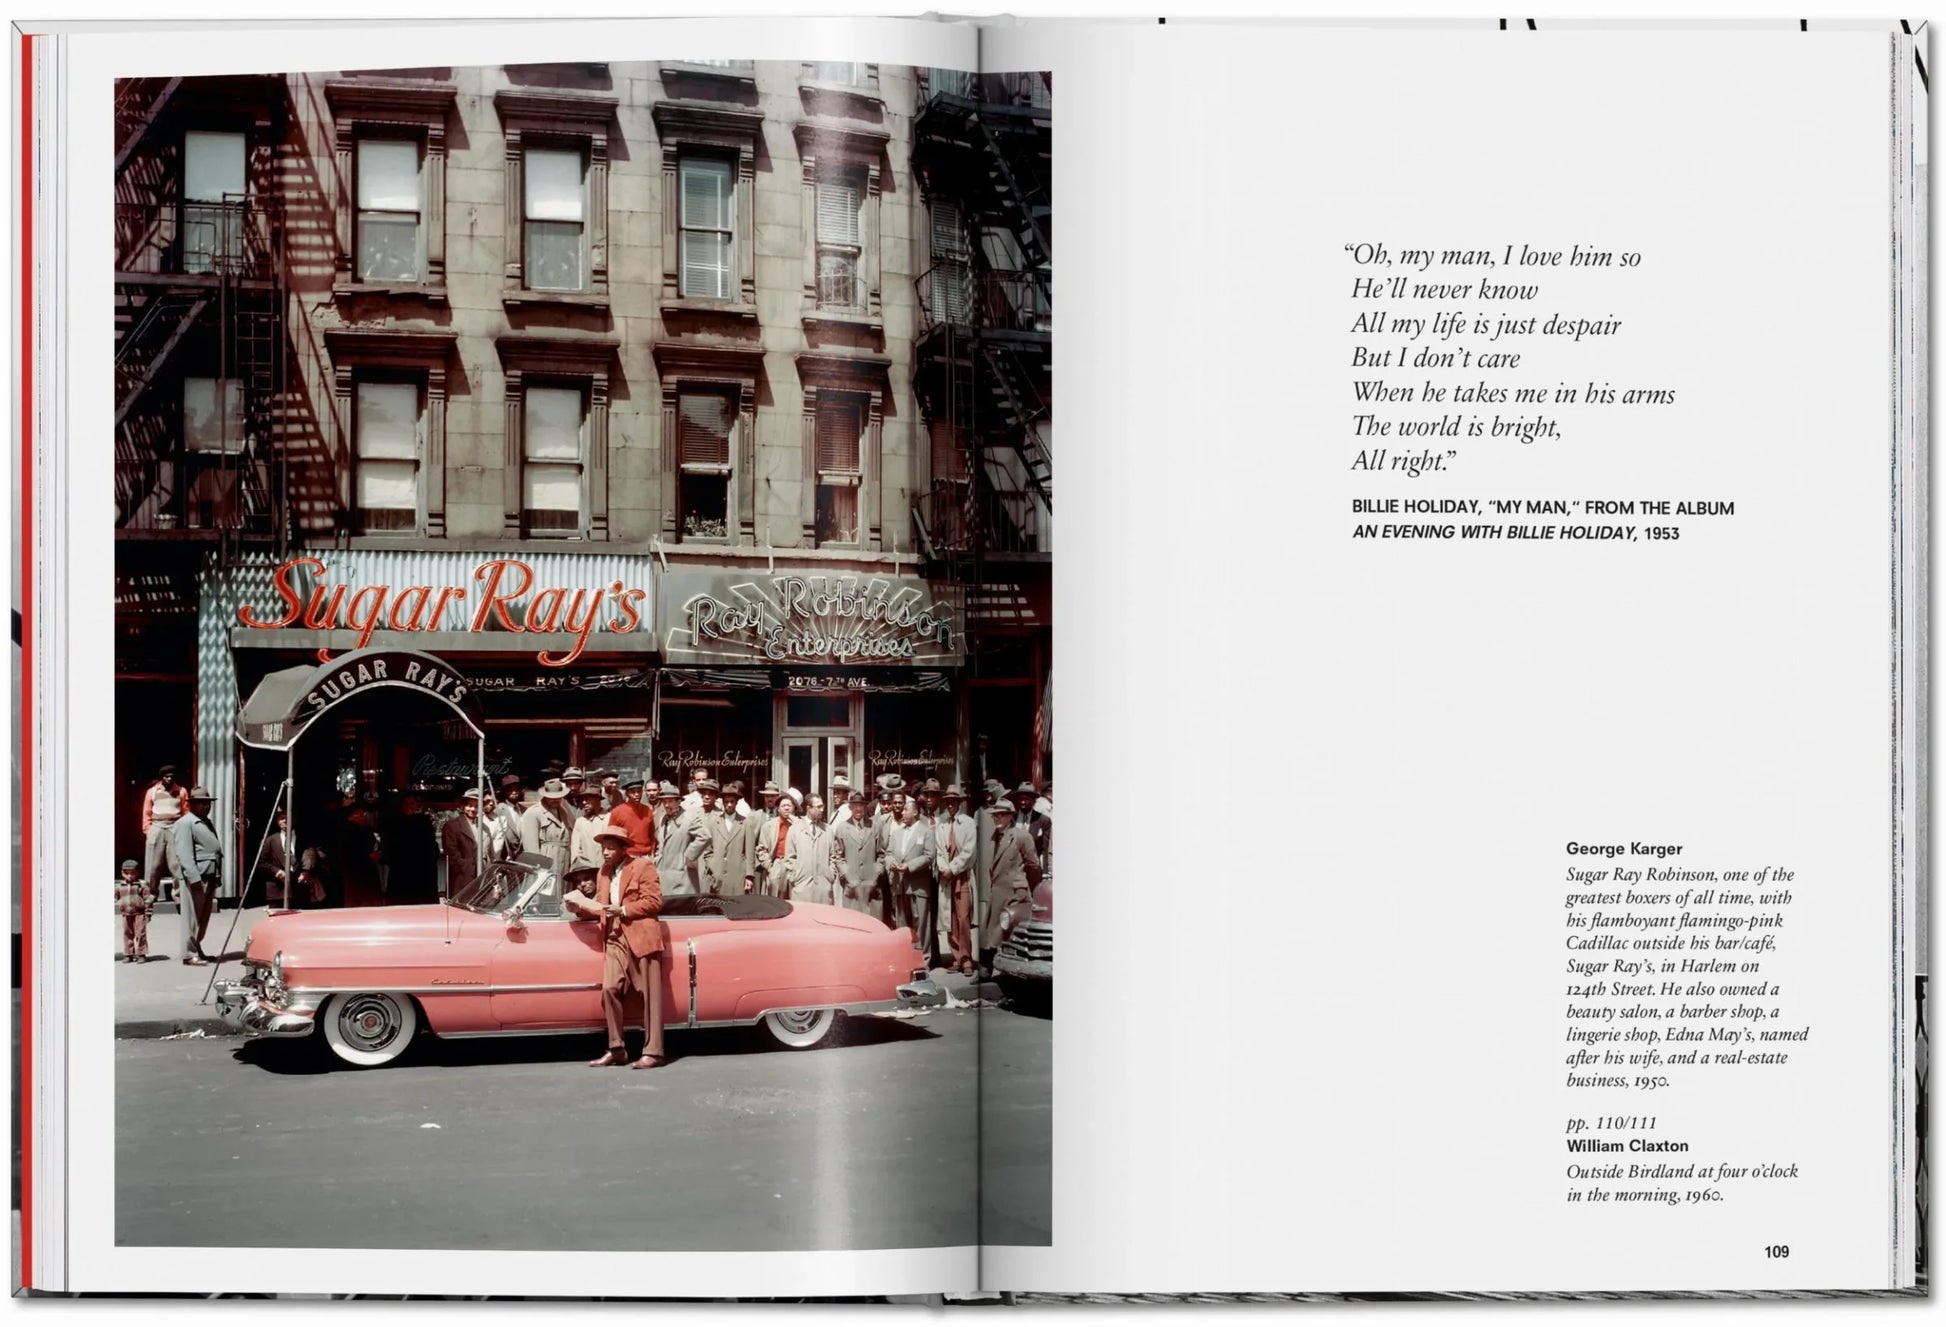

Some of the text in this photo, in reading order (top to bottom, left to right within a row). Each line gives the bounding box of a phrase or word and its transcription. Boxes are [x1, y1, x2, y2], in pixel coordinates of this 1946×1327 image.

[1344, 242, 1641, 272] “Oh, my man, I love him so
[1351, 277, 1538, 300] He’ll never know
[1350, 311, 1622, 341] All my life is just despair
[1351, 346, 1520, 368] But I don’t care
[1353, 380, 1675, 404] When he takes me in his arms
[1353, 414, 1560, 444] The world is bright,
[1351, 448, 1456, 478] All right.”
[1352, 499, 1734, 516] BILLIE HOLIDAY, “MY MAN,“ FROM THE ALBUM
[1352, 524, 1680, 542] AN EVENING WITH BILLIE HOLIDAY, 1953
[239, 557, 647, 667] Sugar Ray’s
[692, 577, 955, 650] Ray Robinson
[766, 624, 916, 663] Enterprises
[307, 659, 467, 710] SUGAR RAY’S
[466, 676, 515, 687] SUGAR
[658, 750, 681, 773] Ray
[1566, 841, 1683, 859] George Karger
[1566, 866, 1794, 886] Sugar Ray Robinson, one of the
[1565, 889, 1792, 908] greatest boxers of all time, with
[1566, 912, 1783, 931] his flamboyant flamingo-pink
[1566, 934, 1775, 954] Cadillac outside his bar/café,
[1566, 958, 1759, 977] Sugar Ray’s, in Harlem on
[1566, 981, 1779, 998] 124th Street. He also owned a
[1566, 1003, 1779, 1022] beauty salon, a barber shop, a
[1566, 1026, 1810, 1046] lingerie shop, Edna May’s, named
[1566, 1049, 1788, 1069] after his wife, and a real-estate
[1566, 1072, 1669, 1090] business, 1950.
[1565, 1116, 1656, 1134] pp. 110/111
[1567, 1139, 1688, 1152] William Claxton
[1567, 1162, 1798, 1182] Outside Birdland at four o’clock
[1567, 1187, 1723, 1206] in the morning, 1960.
[1765, 1245, 1789, 1258] 109
